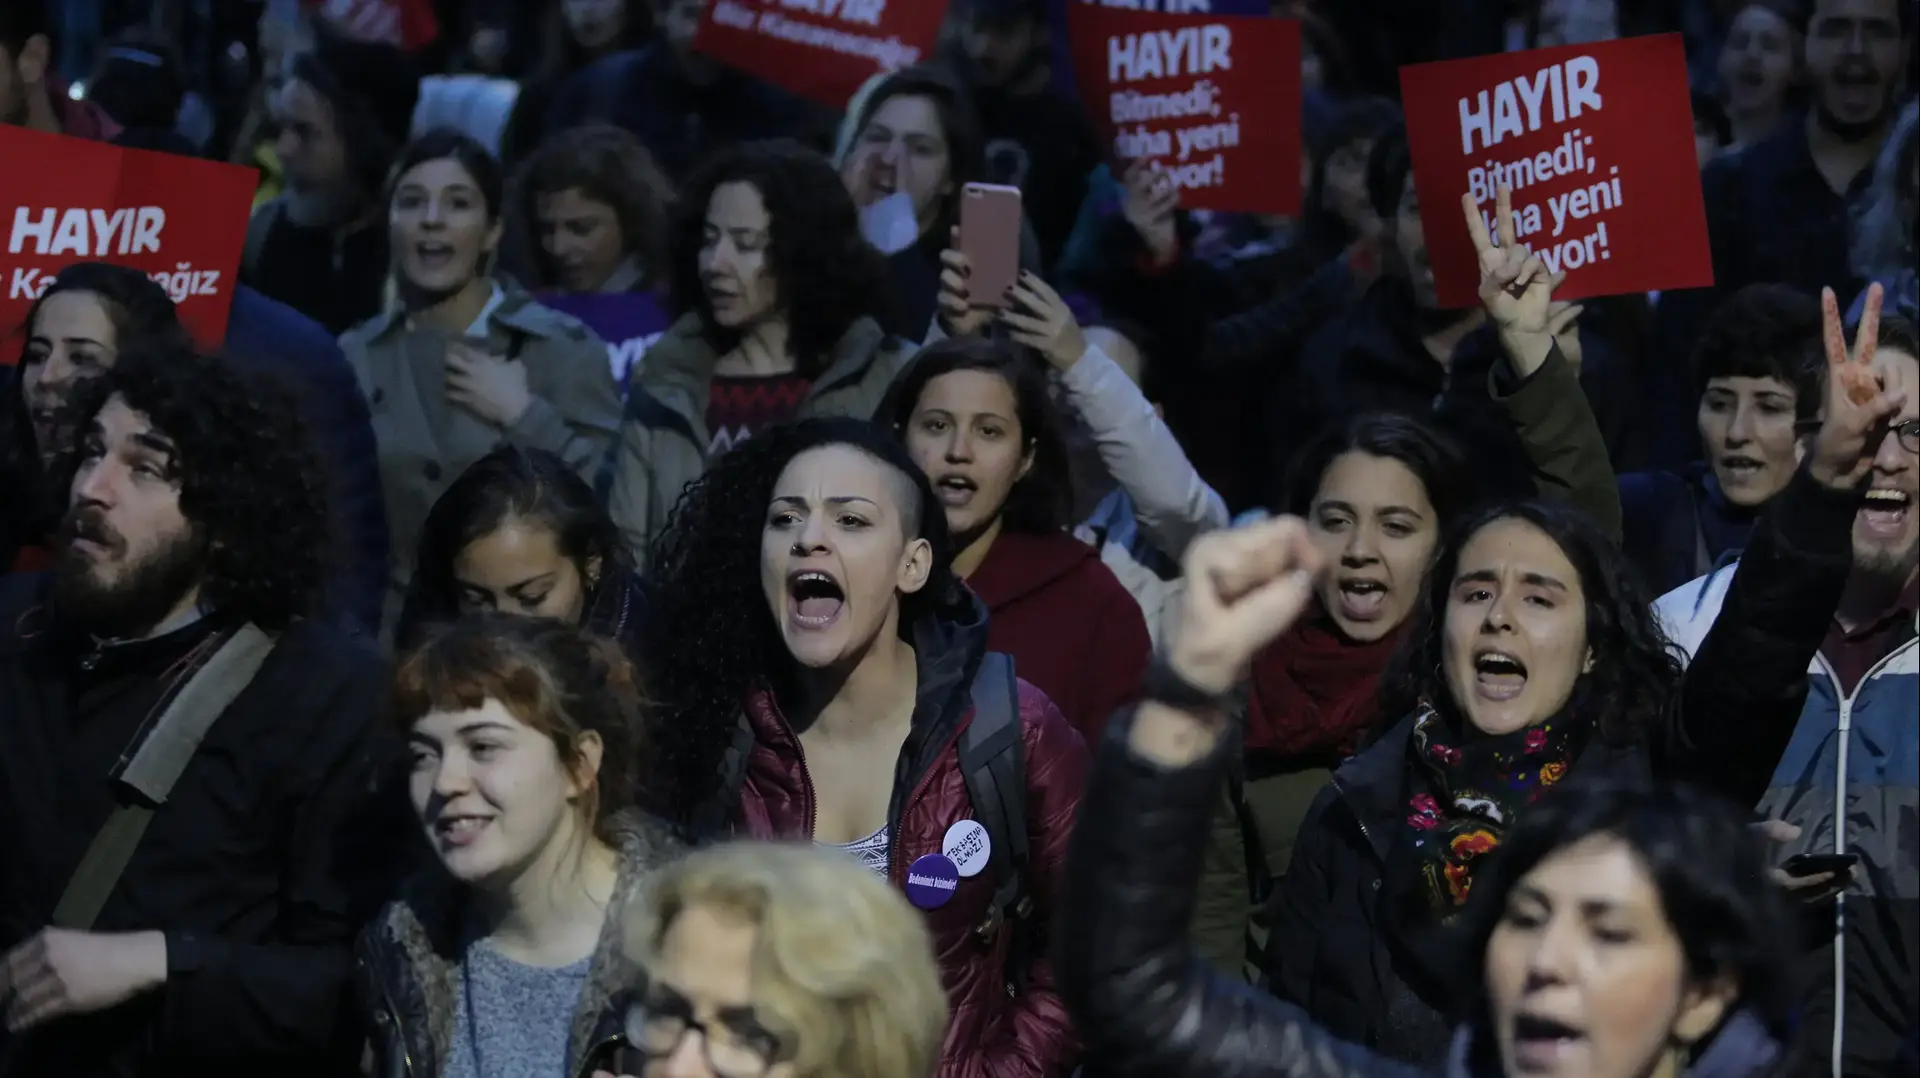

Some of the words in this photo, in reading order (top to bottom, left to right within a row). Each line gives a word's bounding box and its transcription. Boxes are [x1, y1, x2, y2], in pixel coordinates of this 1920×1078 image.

[1107, 23, 1232, 83] HAYIR
[1176, 112, 1240, 161] yeni
[1457, 55, 1603, 155] HAYIR
[1467, 128, 1597, 205] Bitmedi;
[8, 206, 165, 256] HAYIR
[1547, 165, 1623, 237] yeni
